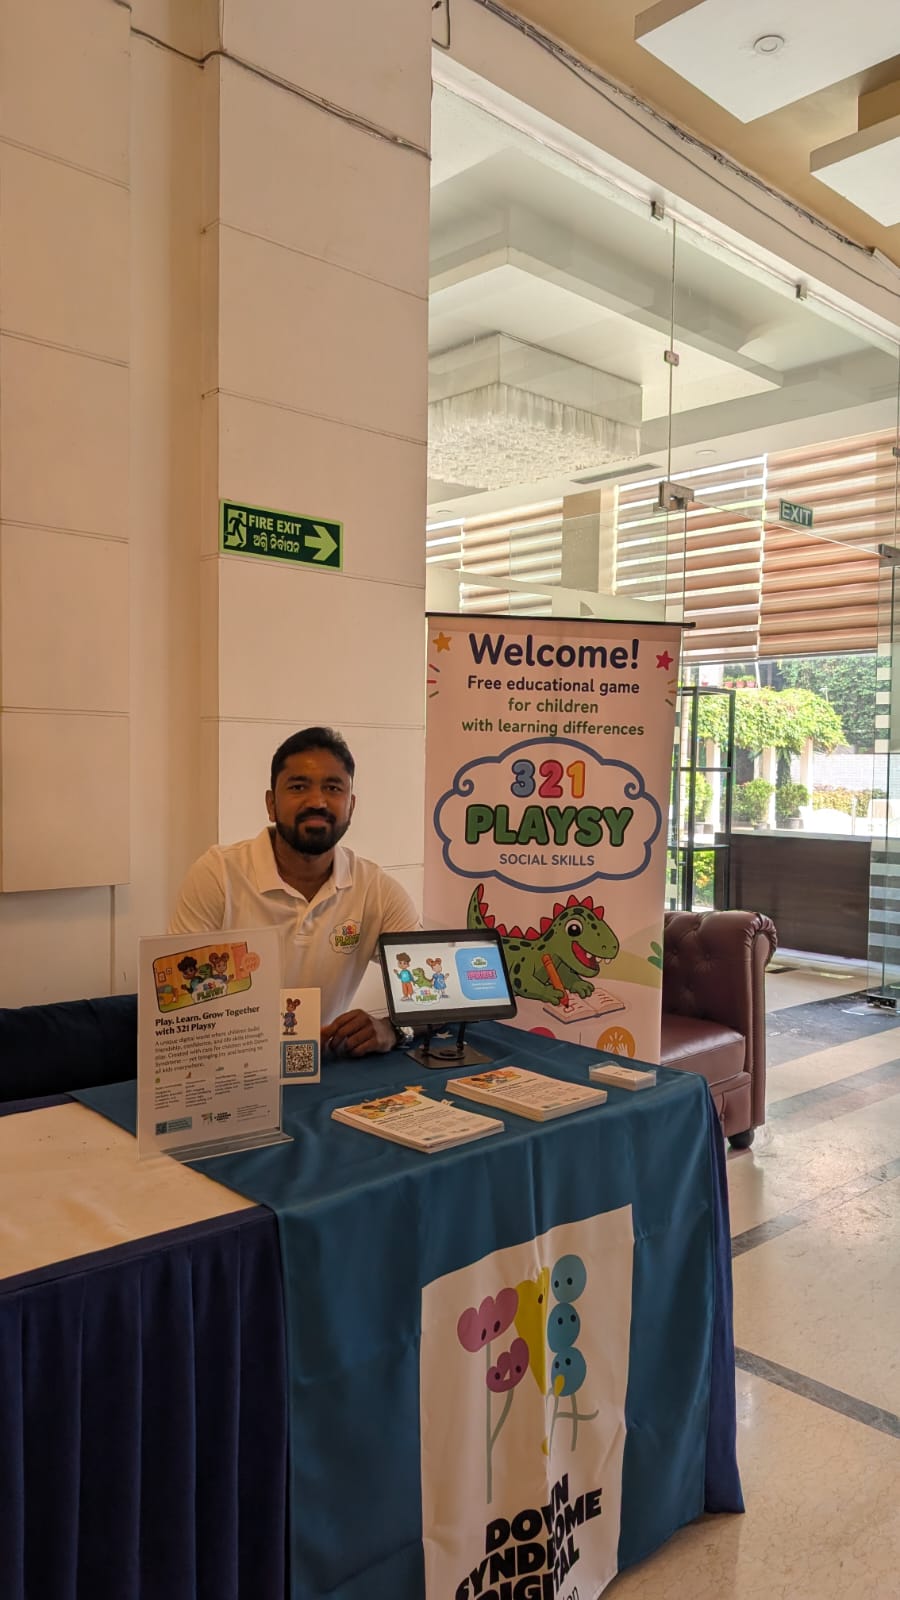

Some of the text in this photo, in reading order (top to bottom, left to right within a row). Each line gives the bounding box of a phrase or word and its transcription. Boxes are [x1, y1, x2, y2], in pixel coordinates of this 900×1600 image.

[782, 502, 811, 525] EXIT
[249, 514, 302, 536] FIRE EXIT
[469, 633, 640, 669] Welcome!
[467, 675, 640, 695] Free educational game
[508, 698, 599, 714] for children
[461, 718, 645, 737] with learning differences
[510, 759, 586, 799] 321
[465, 804, 634, 848] PLAYSY
[499, 853, 595, 867] SOCIAL SKILLS
[155, 1006, 260, 1027] Play. Learn. Grow Together
[155, 1027, 175, 1036] with
[191, 1022, 216, 1031] Playsy
[486, 1473, 568, 1555] DOWN
